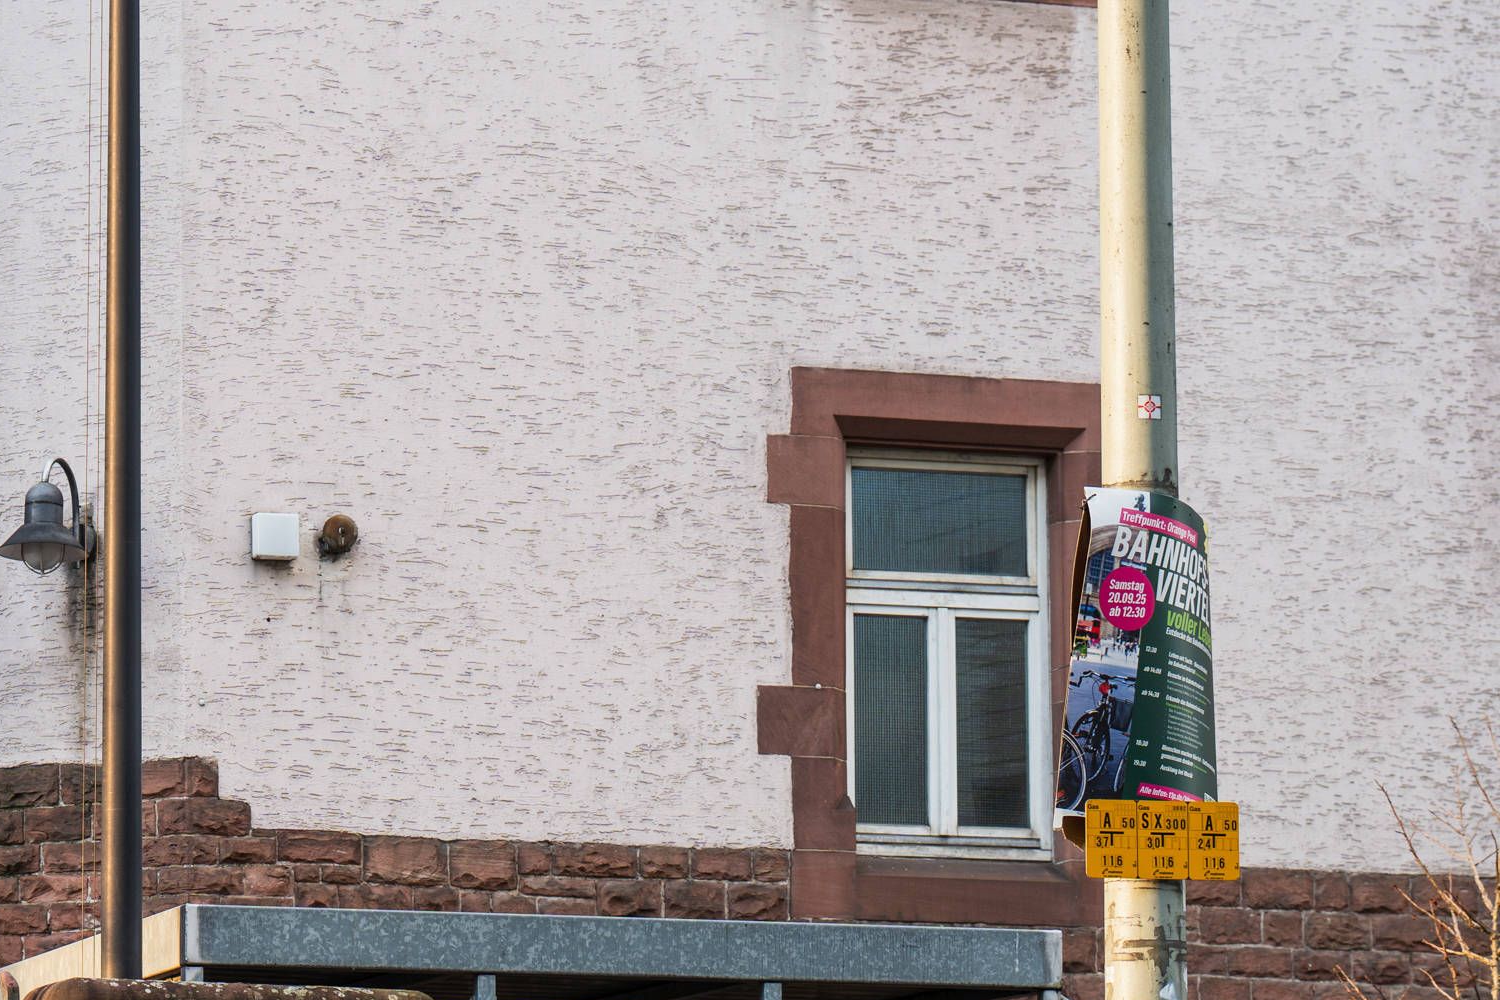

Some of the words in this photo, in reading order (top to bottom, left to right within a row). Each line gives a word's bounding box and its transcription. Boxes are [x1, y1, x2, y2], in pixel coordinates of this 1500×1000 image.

[1122, 511, 1166, 530] Treffpunkt:
[1168, 522, 1186, 539] Orange
[1109, 579, 1145, 593] Samstag
[1108, 592, 1146, 605] 20.09.25
[1108, 606, 1120, 617] ab
[1122, 606, 1146, 618] 12:30
[1167, 610, 1198, 636] voller
[1140, 786, 1152, 795] Alle
[1152, 789, 1168, 798] Infos:
[1104, 812, 1111, 828] A
[1122, 818, 1135, 828] 50
[1142, 813, 1149, 828] S
[1154, 814, 1162, 829] X
[1166, 818, 1186, 830] 300
[1205, 816, 1213, 831] A
[1224, 820, 1237, 831] 50
